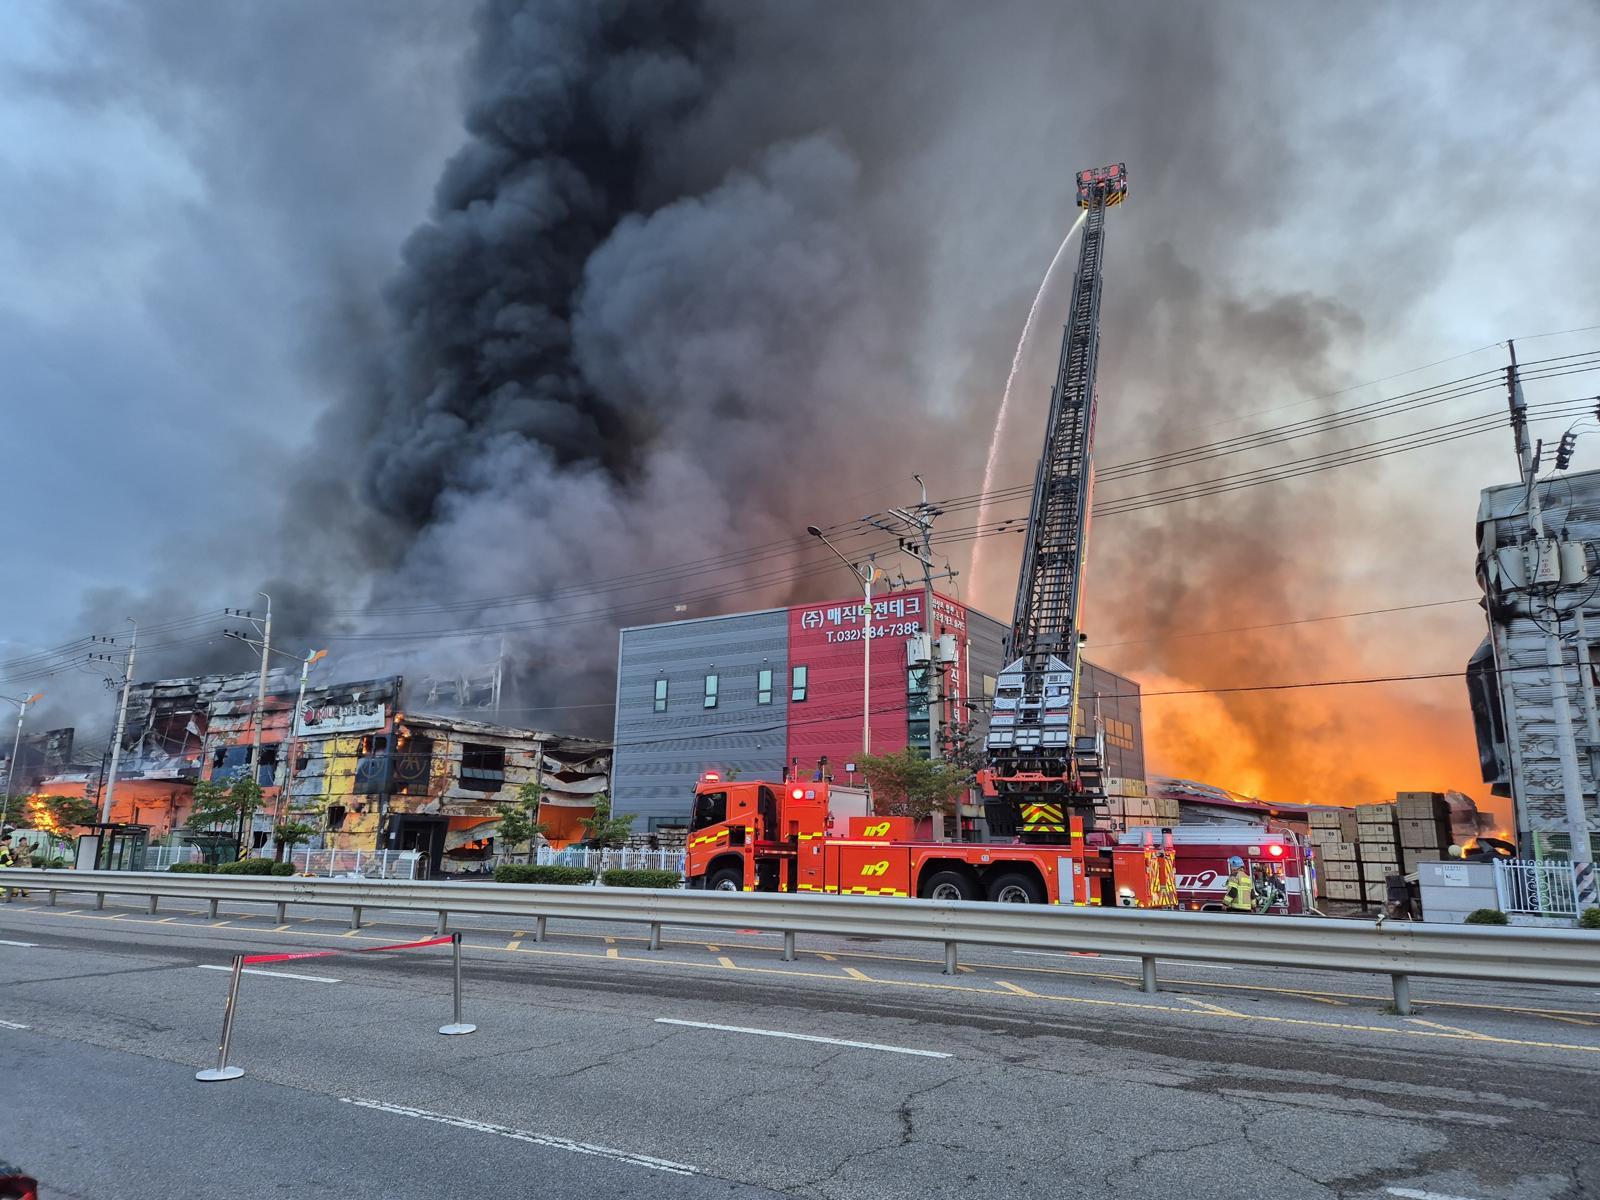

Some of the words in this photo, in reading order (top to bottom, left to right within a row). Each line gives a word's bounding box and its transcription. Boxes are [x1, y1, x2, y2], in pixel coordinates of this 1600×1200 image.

[801, 610, 824, 629] (주)
[863, 822, 891, 836] 119
[860, 860, 890, 876] 119
[1179, 870, 1217, 888] 119
